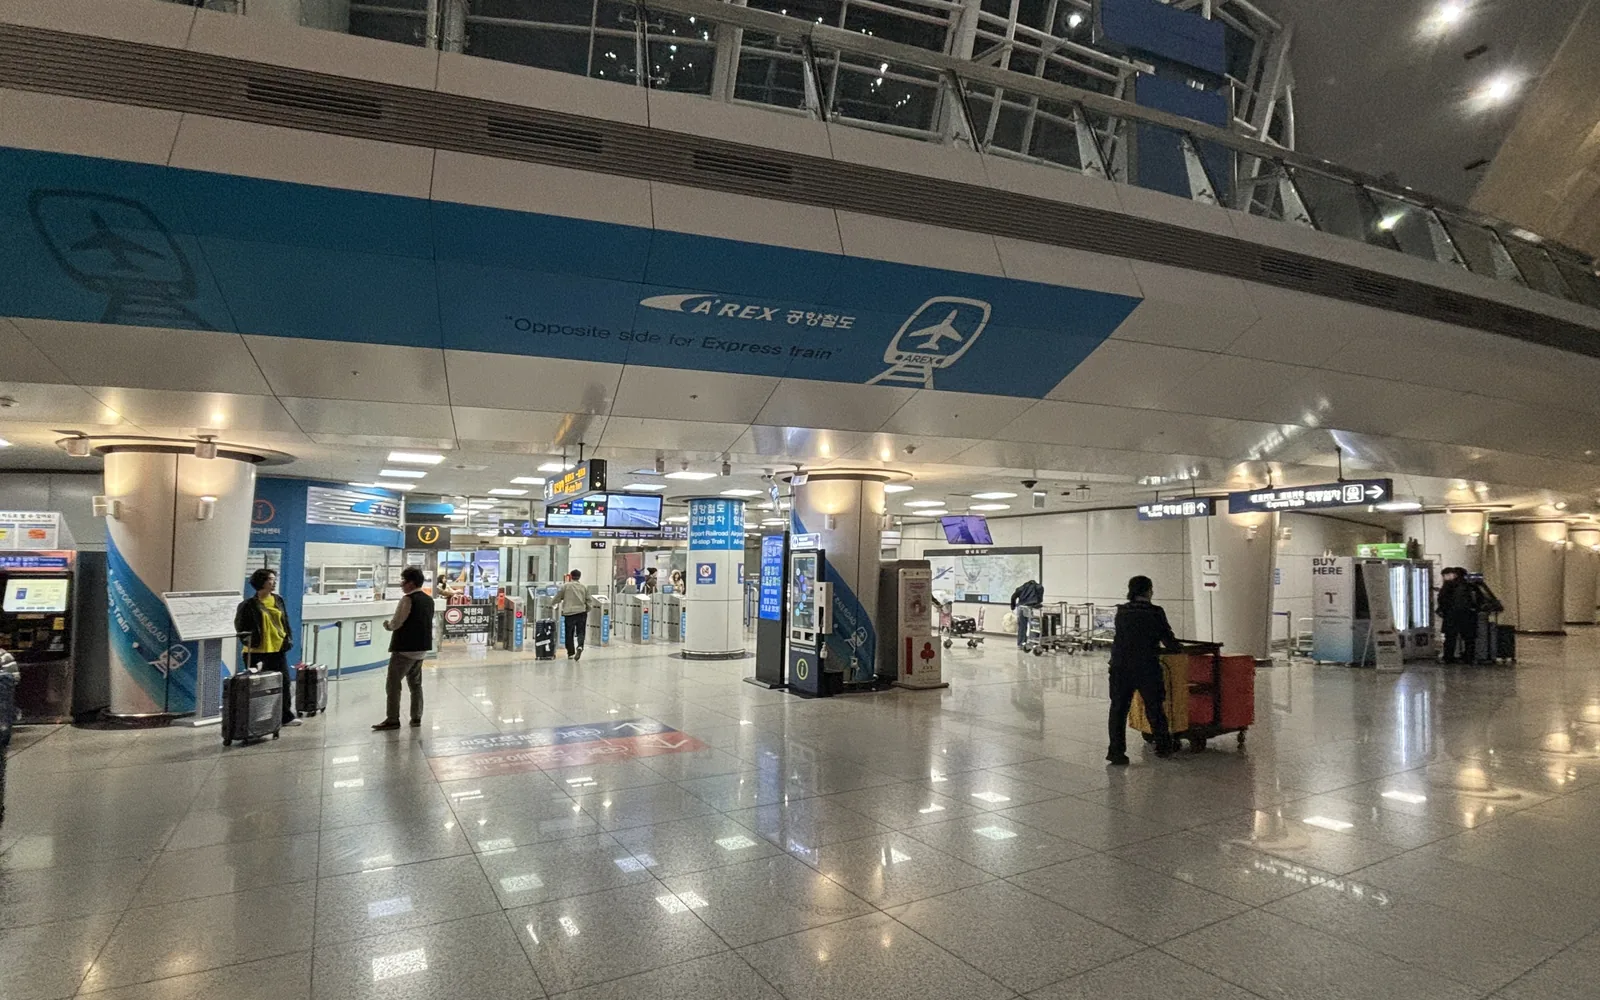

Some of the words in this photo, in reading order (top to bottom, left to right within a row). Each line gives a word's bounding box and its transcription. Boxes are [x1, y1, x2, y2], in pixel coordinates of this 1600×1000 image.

[786, 309, 858, 330] 공항철도
[617, 324, 661, 343] side
[668, 332, 696, 346] for
[701, 336, 783, 358] Express
[903, 354, 937, 365] AREX
[691, 504, 726, 515] 공항철도
[691, 516, 726, 526] 일반열차
[1312, 557, 1337, 567] BUY
[1312, 567, 1343, 576] HERE
[463, 607, 485, 616] 직원외
[113, 607, 131, 633] Train
[132, 607, 169, 643] RAILROAD
[463, 616, 490, 624] 출입금지
